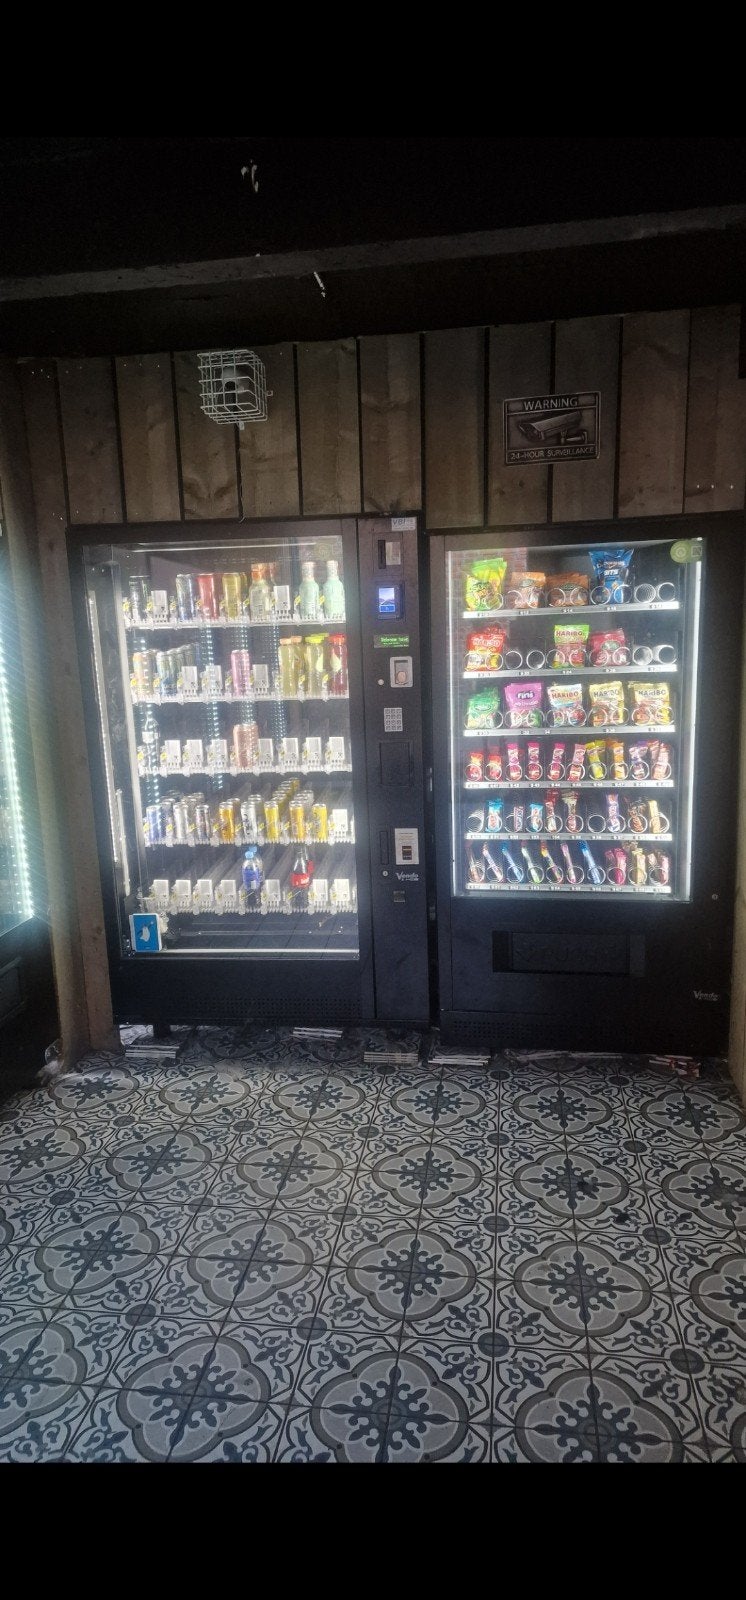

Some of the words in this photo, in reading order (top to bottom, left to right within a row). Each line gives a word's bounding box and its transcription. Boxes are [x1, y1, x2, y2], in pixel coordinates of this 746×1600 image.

[524, 397, 578, 411] WARNING
[510, 450, 545, 460] 24-HOUR
[547, 446, 594, 457] SURVEILLANCE
[556, 629, 584, 637] HARIBO
[517, 690, 534, 699] fini
[551, 691, 579, 699] HARIBO
[638, 689, 667, 697] HARIBO
